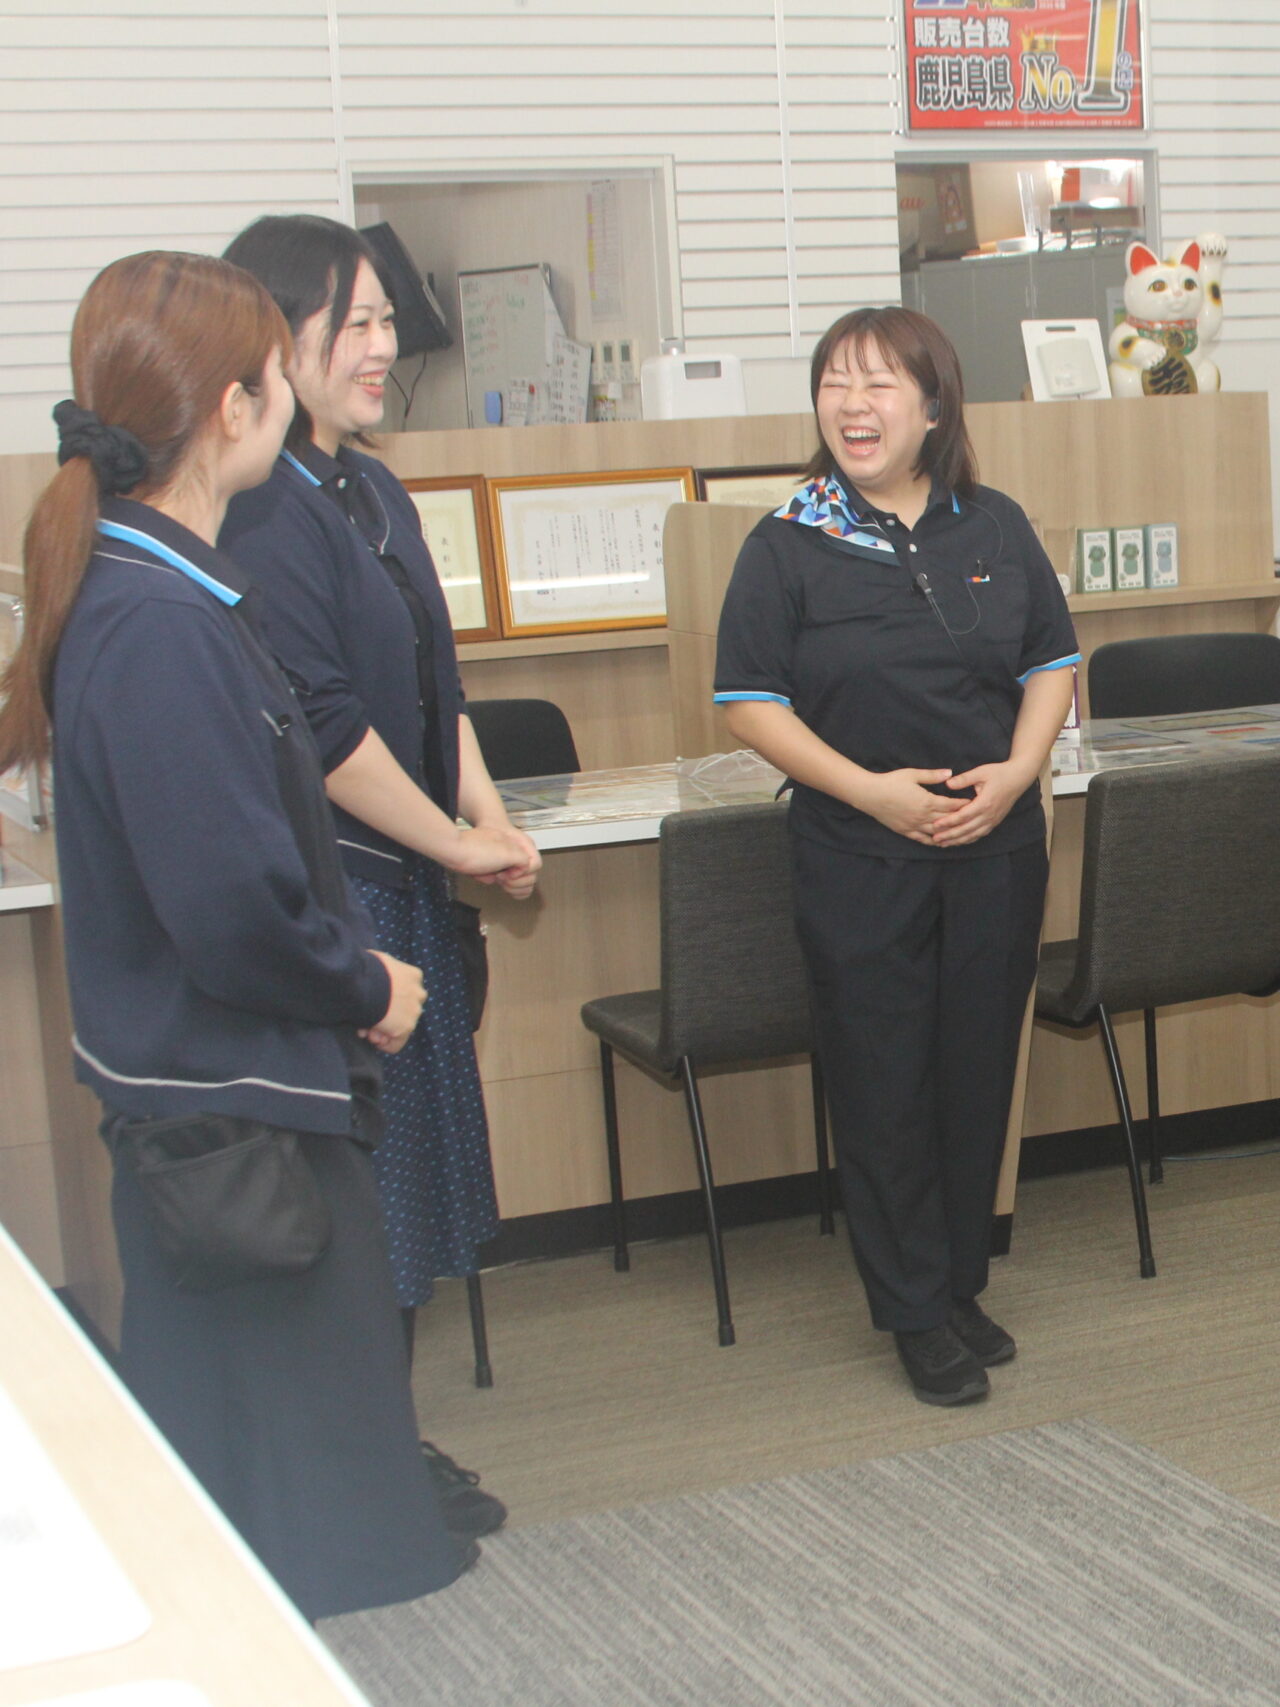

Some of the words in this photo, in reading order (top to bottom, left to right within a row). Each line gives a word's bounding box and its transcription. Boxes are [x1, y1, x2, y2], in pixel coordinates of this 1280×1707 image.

[913, 17, 1010, 48] 販売台数
[915, 54, 1015, 111] 鹿児島県
